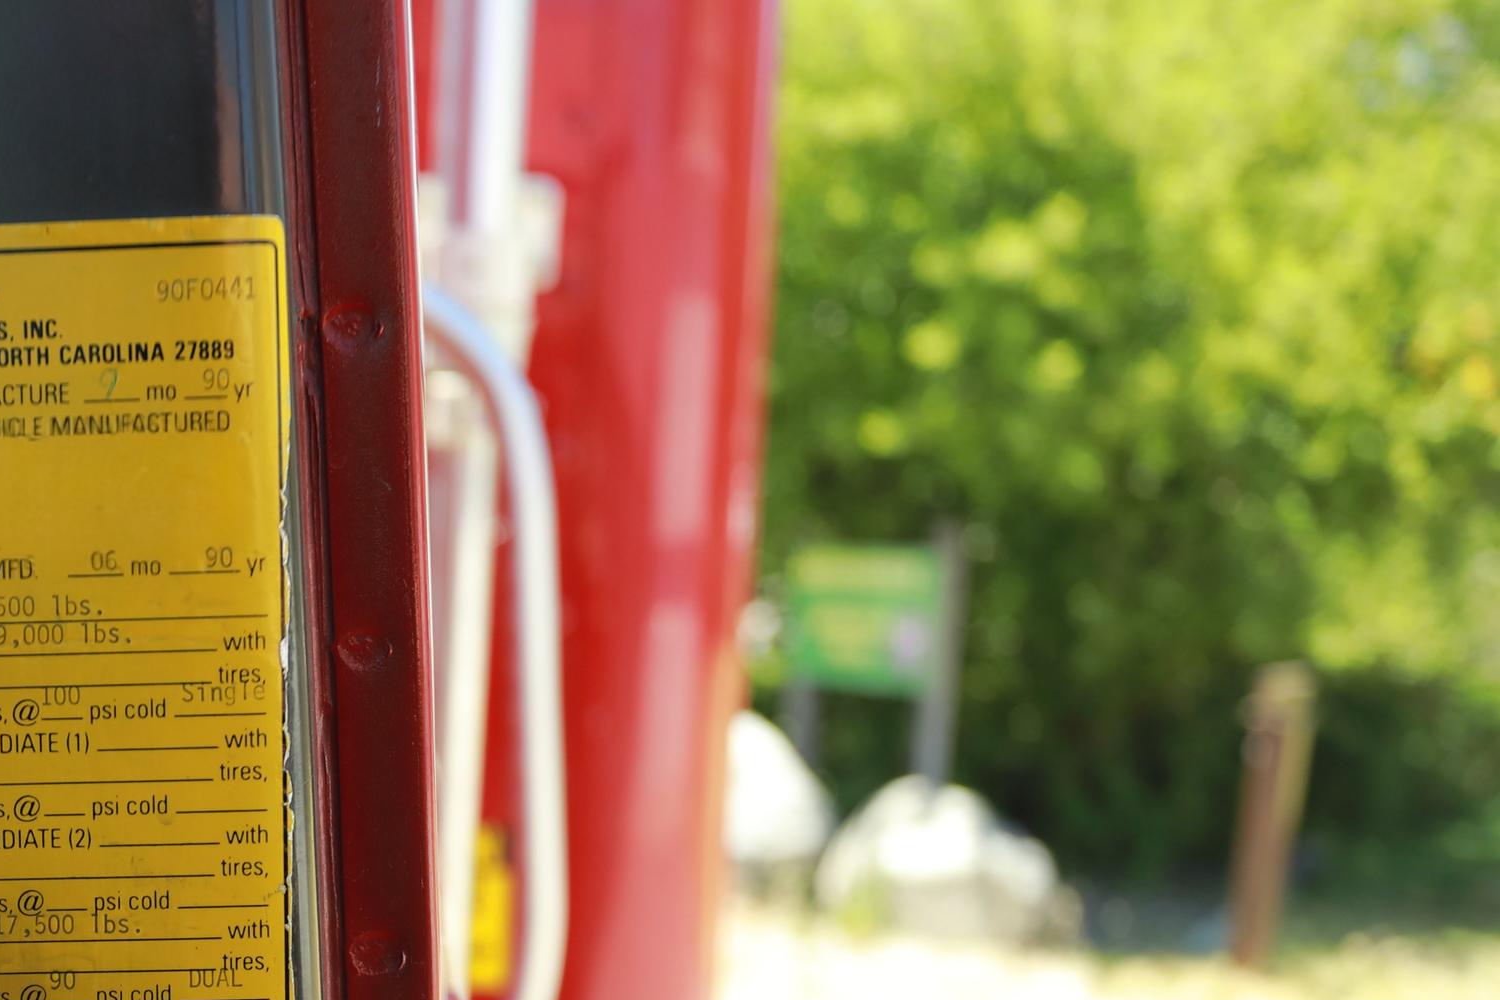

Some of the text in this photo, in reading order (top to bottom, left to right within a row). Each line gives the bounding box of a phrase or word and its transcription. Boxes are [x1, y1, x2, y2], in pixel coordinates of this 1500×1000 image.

[156, 276, 256, 303] 90F0441
[23, 319, 63, 339] INC.
[59, 342, 165, 364] CAROLINA
[175, 340, 235, 361] 27889
[146, 381, 177, 402] mo
[203, 367, 229, 391] 90
[234, 380, 254, 403] yr
[51, 408, 230, 436] MANUFACTURED
[90, 549, 117, 571] 06
[130, 557, 161, 576] mo
[205, 547, 233, 568] 90
[246, 555, 266, 579] yr
[52, 595, 103, 616] lbs.
[82, 623, 132, 645] lbs.
[224, 632, 266, 651] with
[218, 665, 266, 688] tires,
[42, 686, 81, 706] 100
[89, 702, 117, 726] psi
[124, 698, 165, 720] cold
[66, 731, 90, 754] (1)
[225, 729, 267, 748] with
[93, 913, 142, 934] lbs.
[228, 921, 270, 940] with
[222, 952, 270, 974] tires,
[49, 970, 76, 990] 90
[189, 968, 243, 988] DUAL
